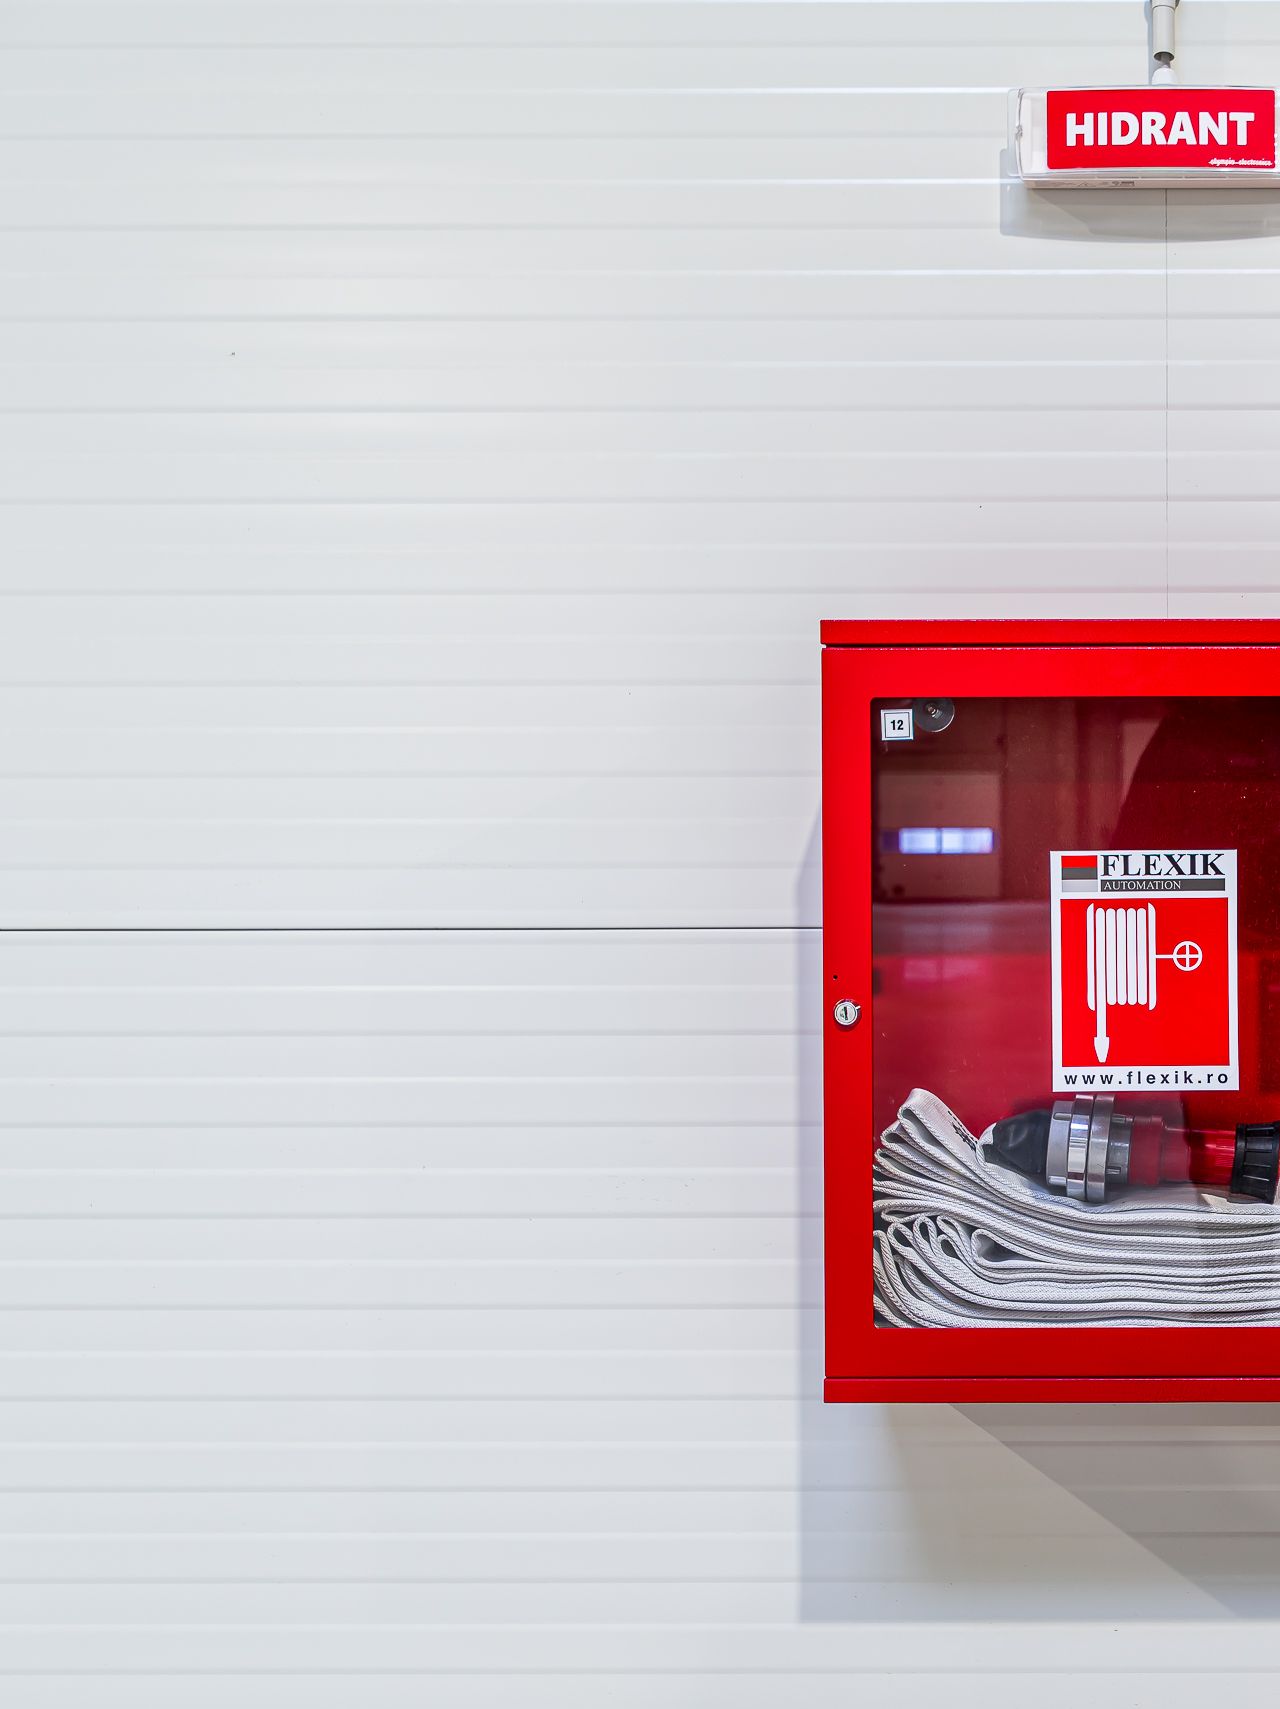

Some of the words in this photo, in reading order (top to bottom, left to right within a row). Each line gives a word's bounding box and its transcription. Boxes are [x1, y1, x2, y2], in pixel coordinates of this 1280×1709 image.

[1066, 112, 1255, 146] HIDRANT
[890, 719, 904, 730] 12
[1101, 853, 1226, 877] FLEXIK
[1103, 880, 1181, 890] AUTOMATION
[1064, 1070, 1229, 1085] www.flexik.ro
